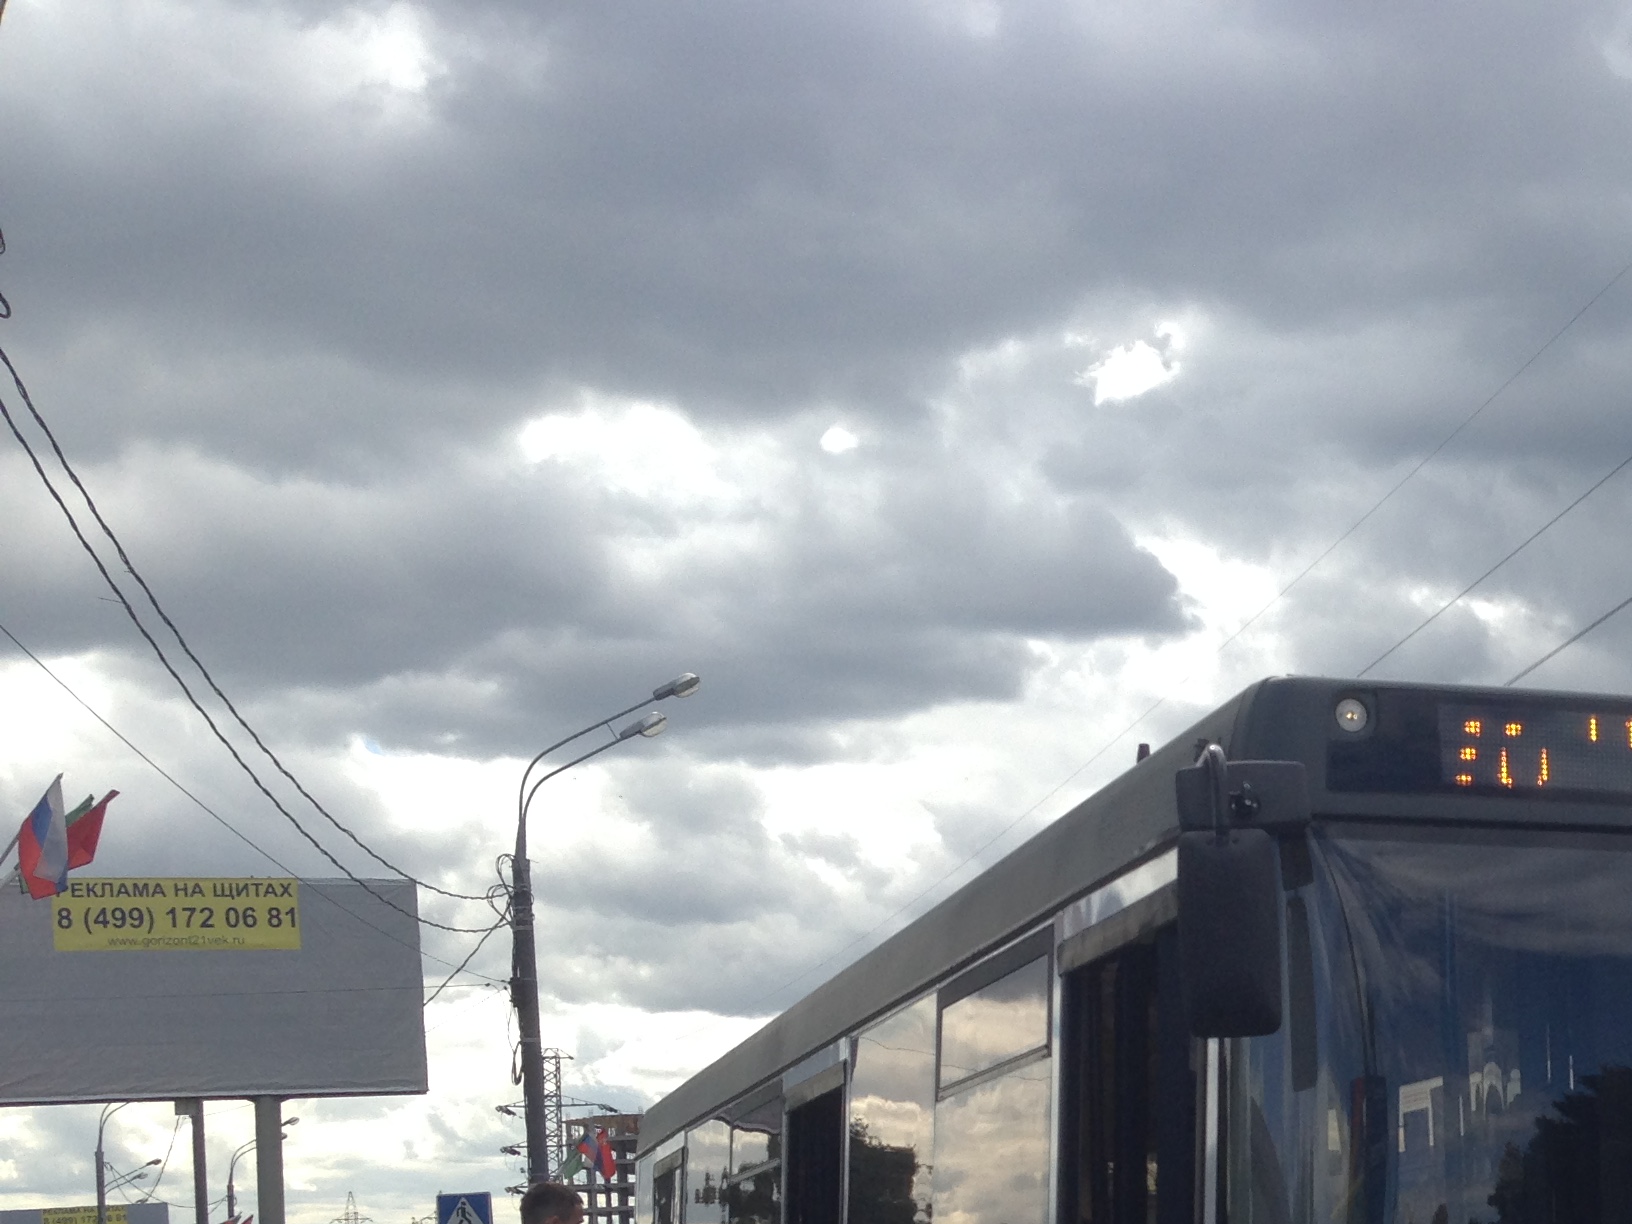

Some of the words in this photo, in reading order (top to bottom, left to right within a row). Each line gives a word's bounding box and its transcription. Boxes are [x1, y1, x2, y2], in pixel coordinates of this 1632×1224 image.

[174, 883, 205, 898] НА
[213, 883, 293, 900] ЩИТАХ
[57, 907, 72, 929] 8
[84, 907, 154, 934] (499)
[166, 907, 215, 928] 172
[225, 907, 257, 929] 06
[268, 907, 296, 929] 81
